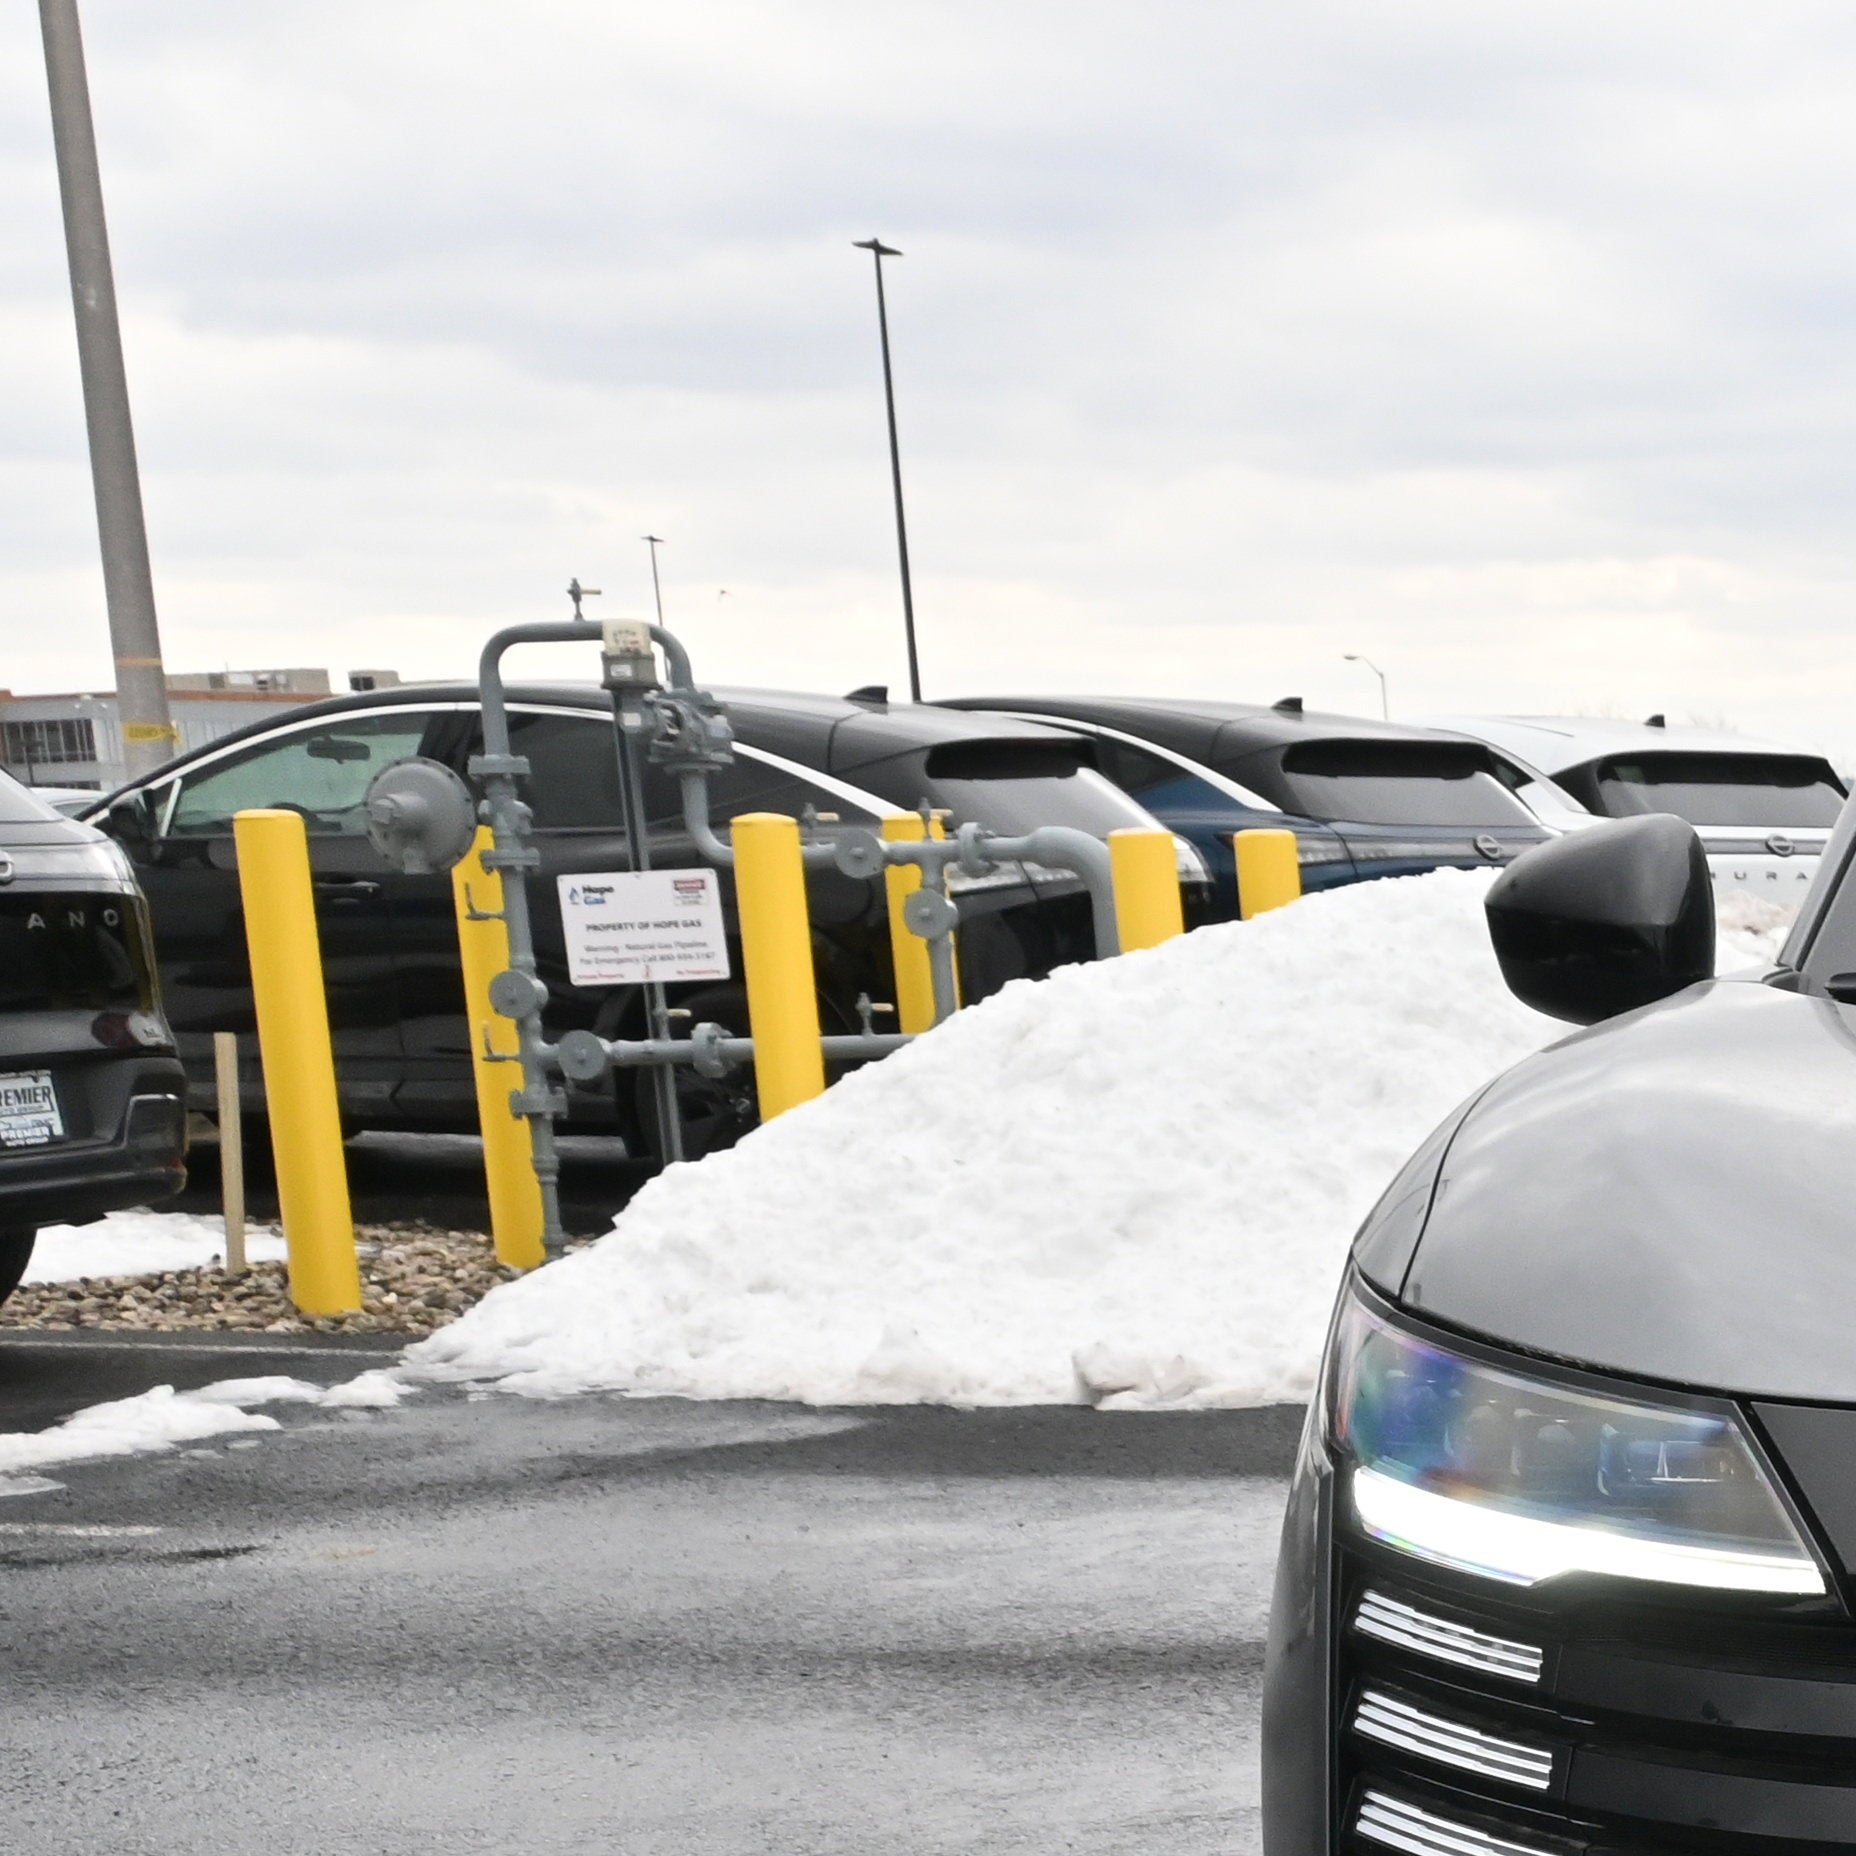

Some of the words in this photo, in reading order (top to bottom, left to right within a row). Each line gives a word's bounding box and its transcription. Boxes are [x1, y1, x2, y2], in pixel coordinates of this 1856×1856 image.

[582, 885, 614, 896] Hope
[586, 922, 634, 932] PROPERTY
[637, 921, 650, 930] OF
[653, 920, 679, 929] HOPE
[682, 918, 702, 928] GAS
